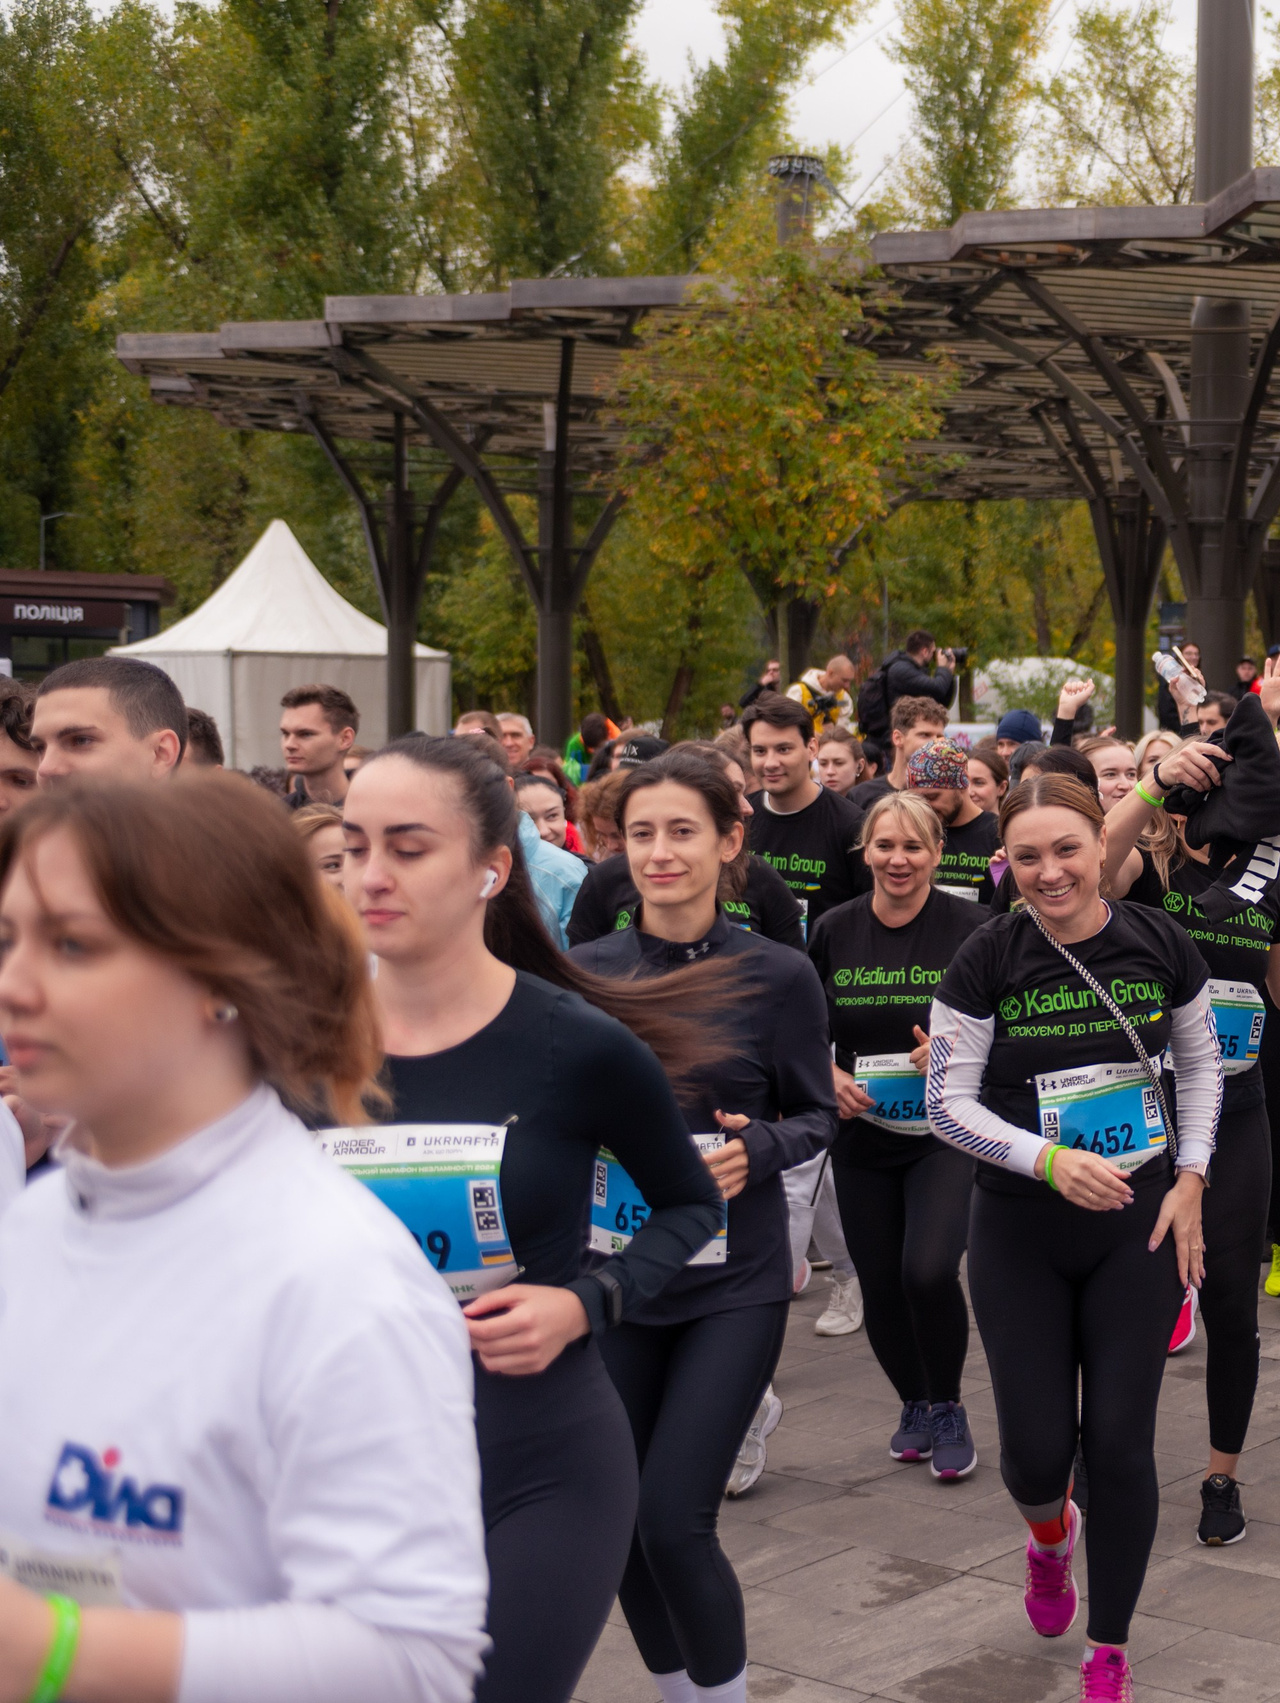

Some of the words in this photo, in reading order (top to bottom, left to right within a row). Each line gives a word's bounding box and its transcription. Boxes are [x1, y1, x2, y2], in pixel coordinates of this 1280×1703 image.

[789, 853, 827, 878] Group
[959, 852, 990, 872] Group
[723, 901, 751, 919] oup
[1216, 934, 1229, 944] ДО
[1231, 936, 1266, 950] ПЕРЕМОГИ
[853, 966, 906, 986] Kadium
[875, 995, 888, 1007] ДО
[1110, 978, 1166, 1007] Group
[1008, 1024, 1066, 1038] КРОКУЄМО
[1068, 1023, 1086, 1037] ДО
[1089, 1014, 1150, 1034] ПЕРЕОГИ
[1218, 1034, 1240, 1057] 55
[1059, 1074, 1089, 1084] UNDER
[1061, 1077, 1096, 1089] ARMOUR
[875, 1100, 927, 1120] 6654
[333, 1138, 376, 1149] UNDER
[423, 1135, 500, 1147] UKRNAFTA
[332, 1146, 387, 1157] ARMOUR
[615, 1201, 647, 1235] 65
